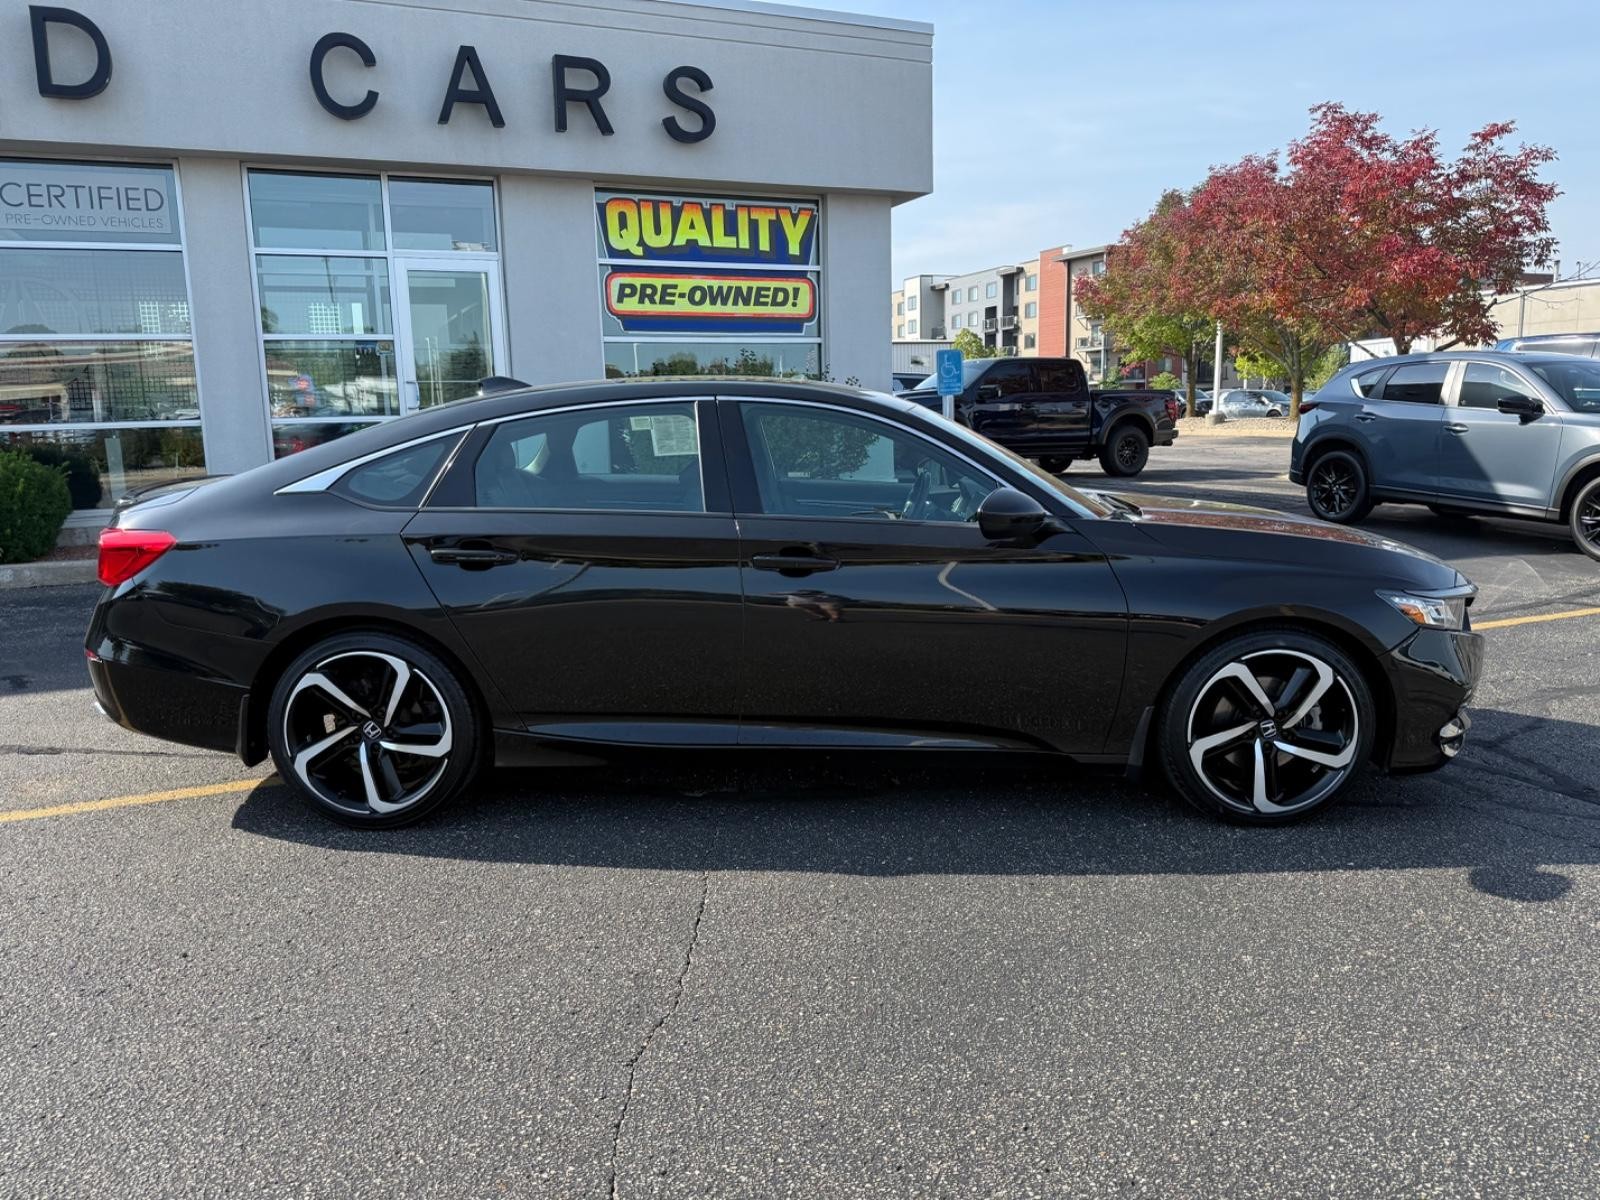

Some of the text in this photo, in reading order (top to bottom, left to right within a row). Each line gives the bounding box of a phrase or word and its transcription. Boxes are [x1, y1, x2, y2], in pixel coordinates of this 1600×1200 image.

[309, 31, 717, 145] CARS
[0, 182, 165, 212] CERTIFIED
[5, 213, 164, 229] PRE-OWNED VEHICLES
[604, 197, 814, 257] QUALITY
[616, 282, 801, 308] PRE-OWNED!
